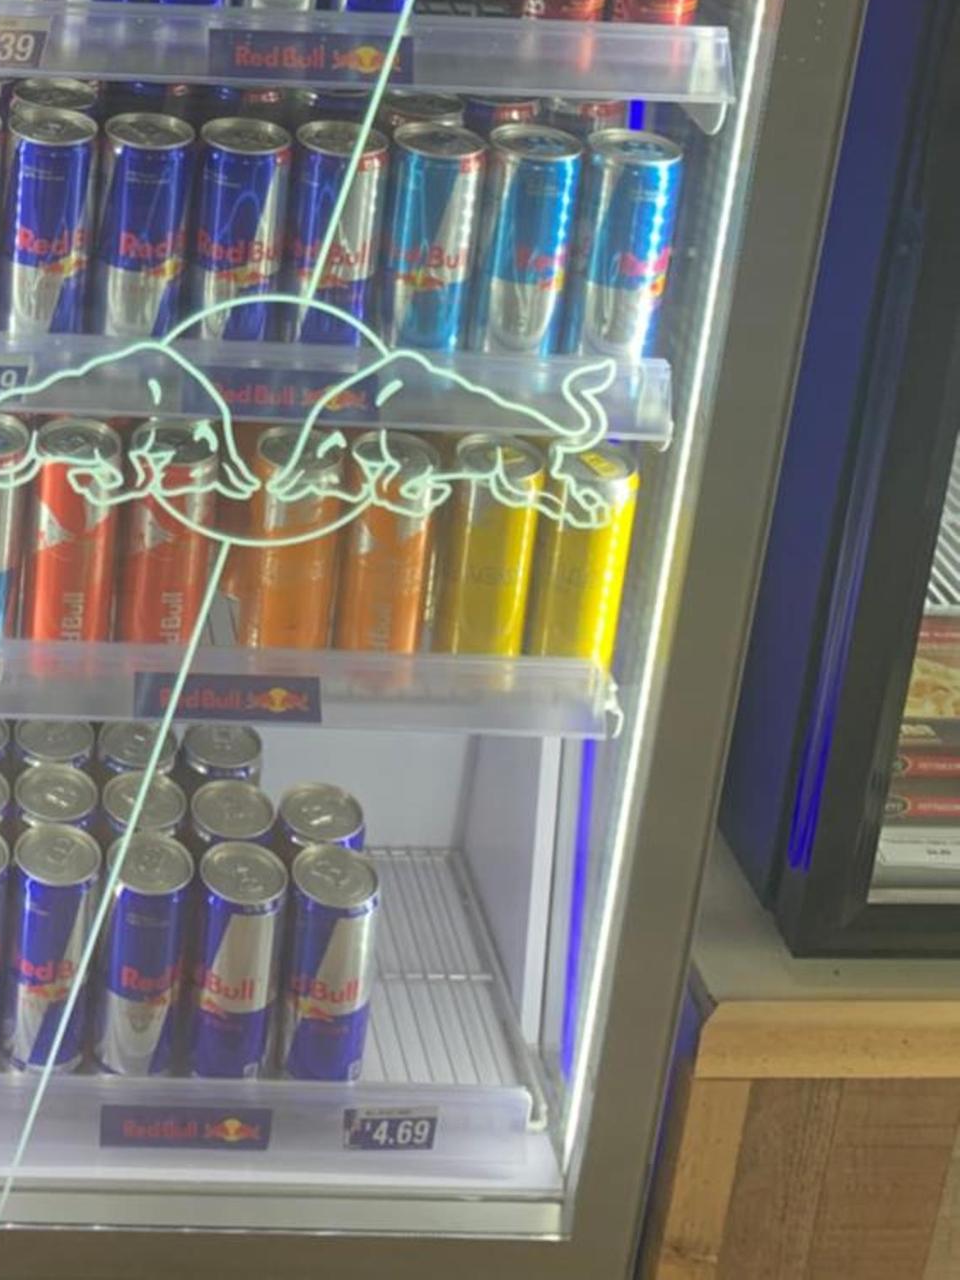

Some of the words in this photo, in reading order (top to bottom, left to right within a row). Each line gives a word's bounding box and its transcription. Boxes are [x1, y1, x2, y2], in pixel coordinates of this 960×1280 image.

[235, 44, 279, 68] Red
[282, 46, 326, 72] Bull
[255, 383, 295, 406] Bull
[159, 687, 200, 710] Rd
[201, 689, 242, 711] Bull
[207, 971, 255, 1002] Bull
[311, 978, 361, 1005] Bull
[123, 1119, 160, 1140] Red
[160, 1120, 197, 1141] Bull
[365, 1120, 431, 1146] $4.69
